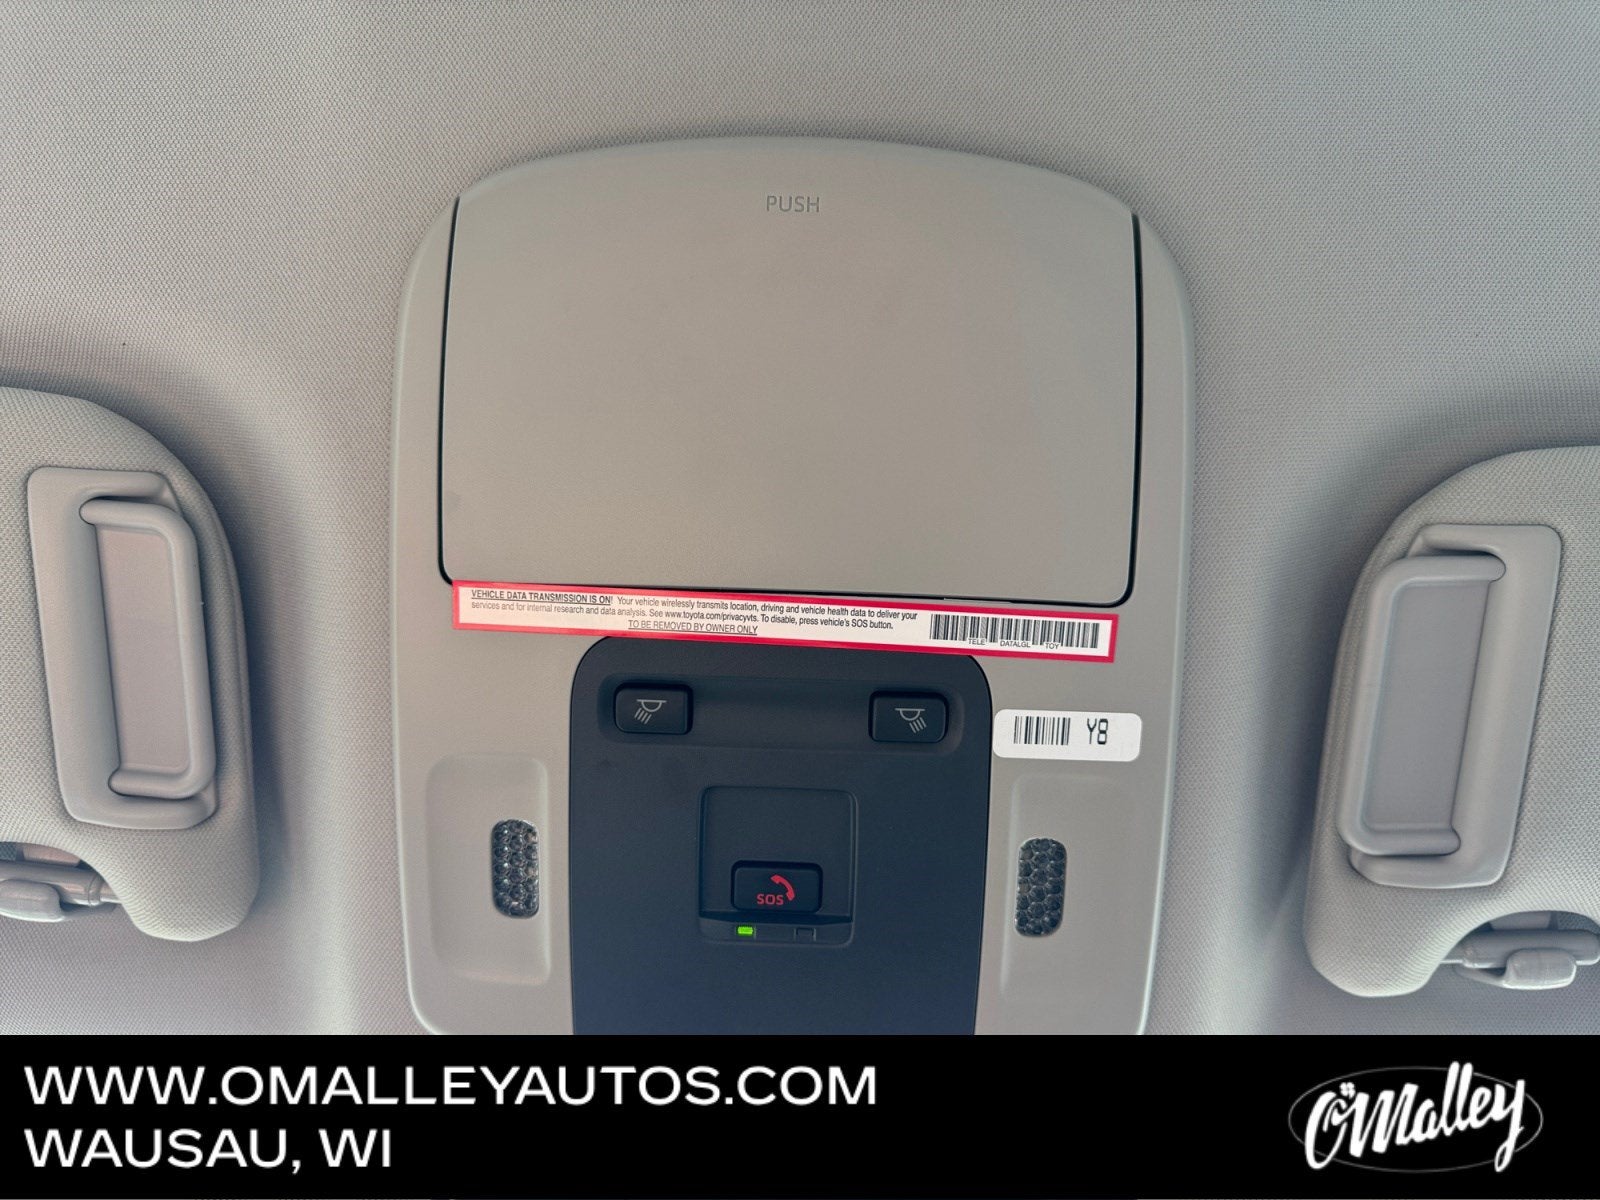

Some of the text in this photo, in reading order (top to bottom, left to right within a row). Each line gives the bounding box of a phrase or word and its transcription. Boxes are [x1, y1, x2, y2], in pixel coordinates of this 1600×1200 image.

[766, 195, 820, 213] PUSH
[471, 589, 918, 621] VEHICLE DATA TRANSMISSION IS ON! Your vehicle wirelessly transmits location, driving and vehicle health data to deliver your
[471, 601, 500, 610] services
[501, 602, 515, 611] and
[516, 603, 525, 611] for
[527, 604, 552, 612] internal
[554, 605, 584, 614] research
[586, 606, 599, 615] and
[600, 607, 616, 615] data
[617, 608, 647, 618] analysis.
[649, 609, 663, 618] See
[760, 613, 769, 622] To
[771, 614, 797, 625] disable,
[799, 617, 818, 626] press
[820, 617, 850, 627] vehicle's
[851, 619, 868, 628] SOS
[869, 620, 893, 630] button.
[628, 620, 758, 634] TO BE REMOVED BY OWNER ONLY
[1000, 640, 1031, 648] DATALGL
[1045, 642, 1060, 650] TOY
[1086, 718, 1109, 745] Y8
[756, 893, 784, 906] SOS
